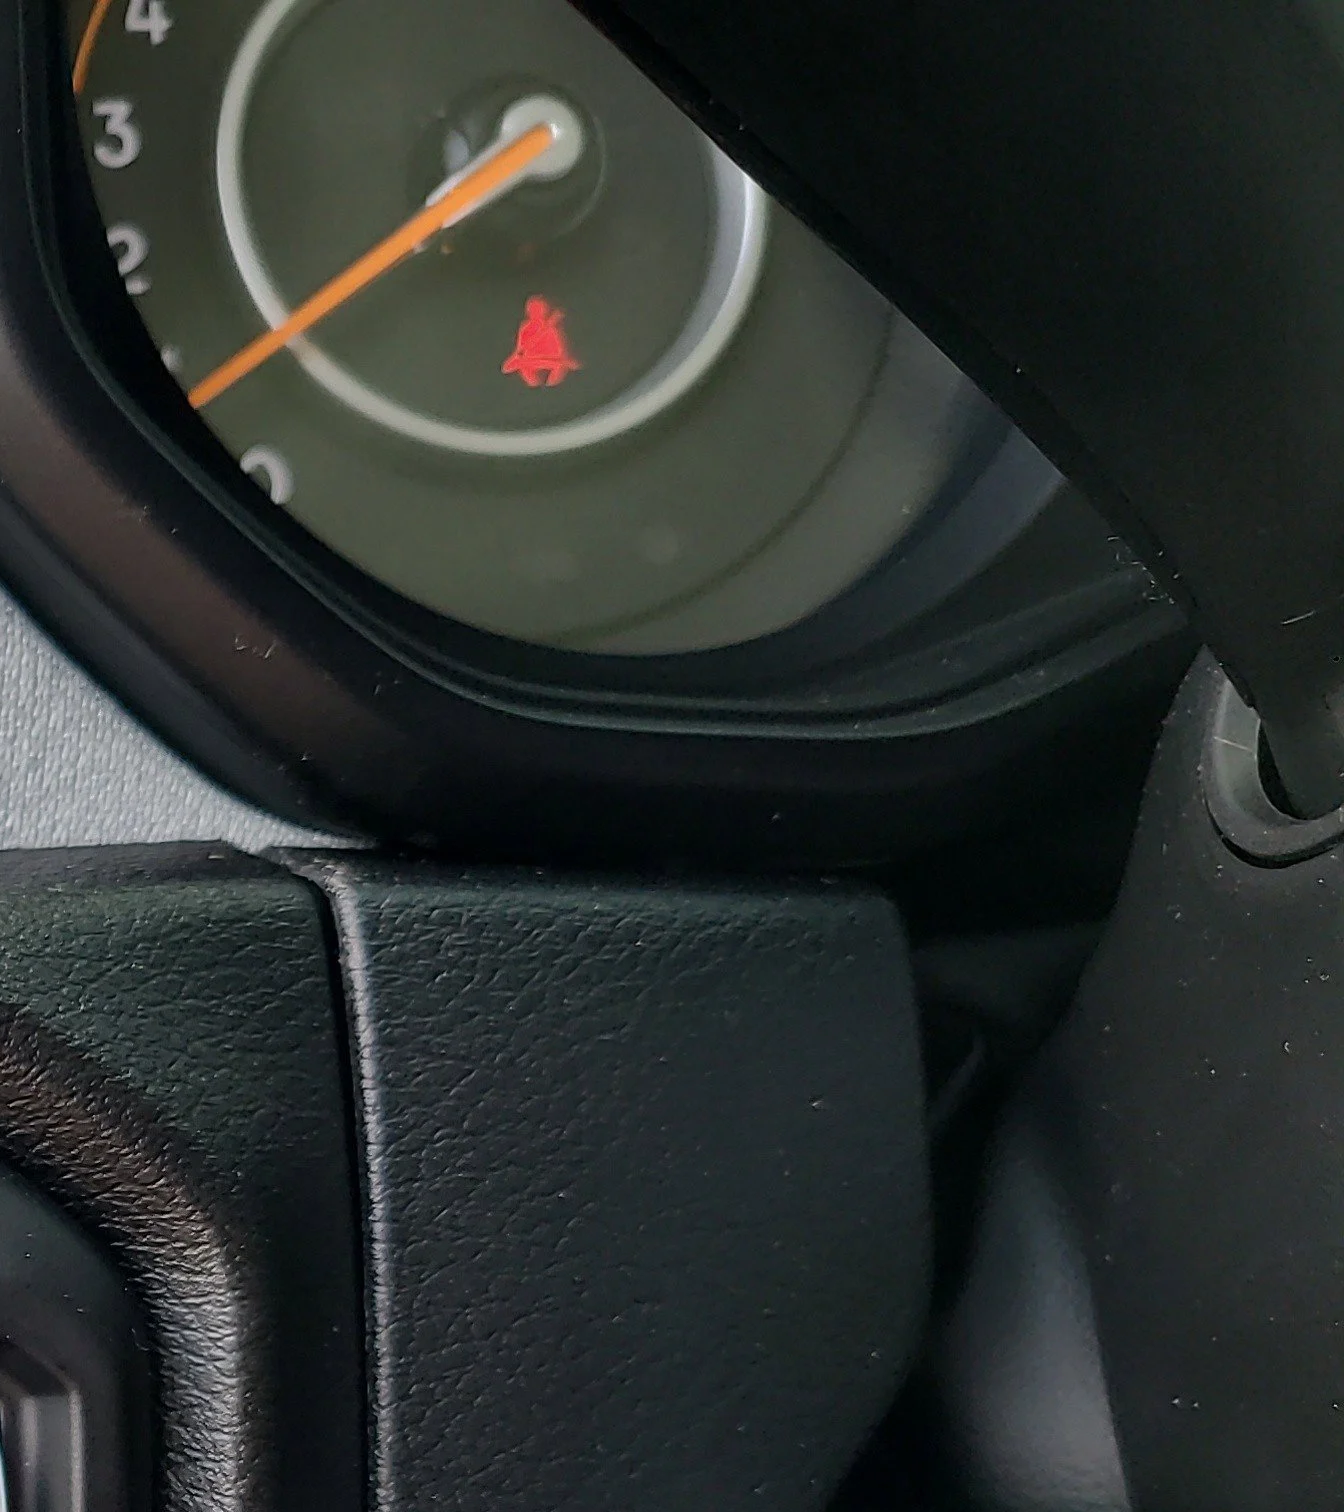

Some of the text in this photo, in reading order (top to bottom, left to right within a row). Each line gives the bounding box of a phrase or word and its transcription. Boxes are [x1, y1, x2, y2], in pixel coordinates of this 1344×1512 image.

[124, 0, 172, 45] 4
[92, 98, 141, 168] 3
[107, 225, 151, 295] 2
